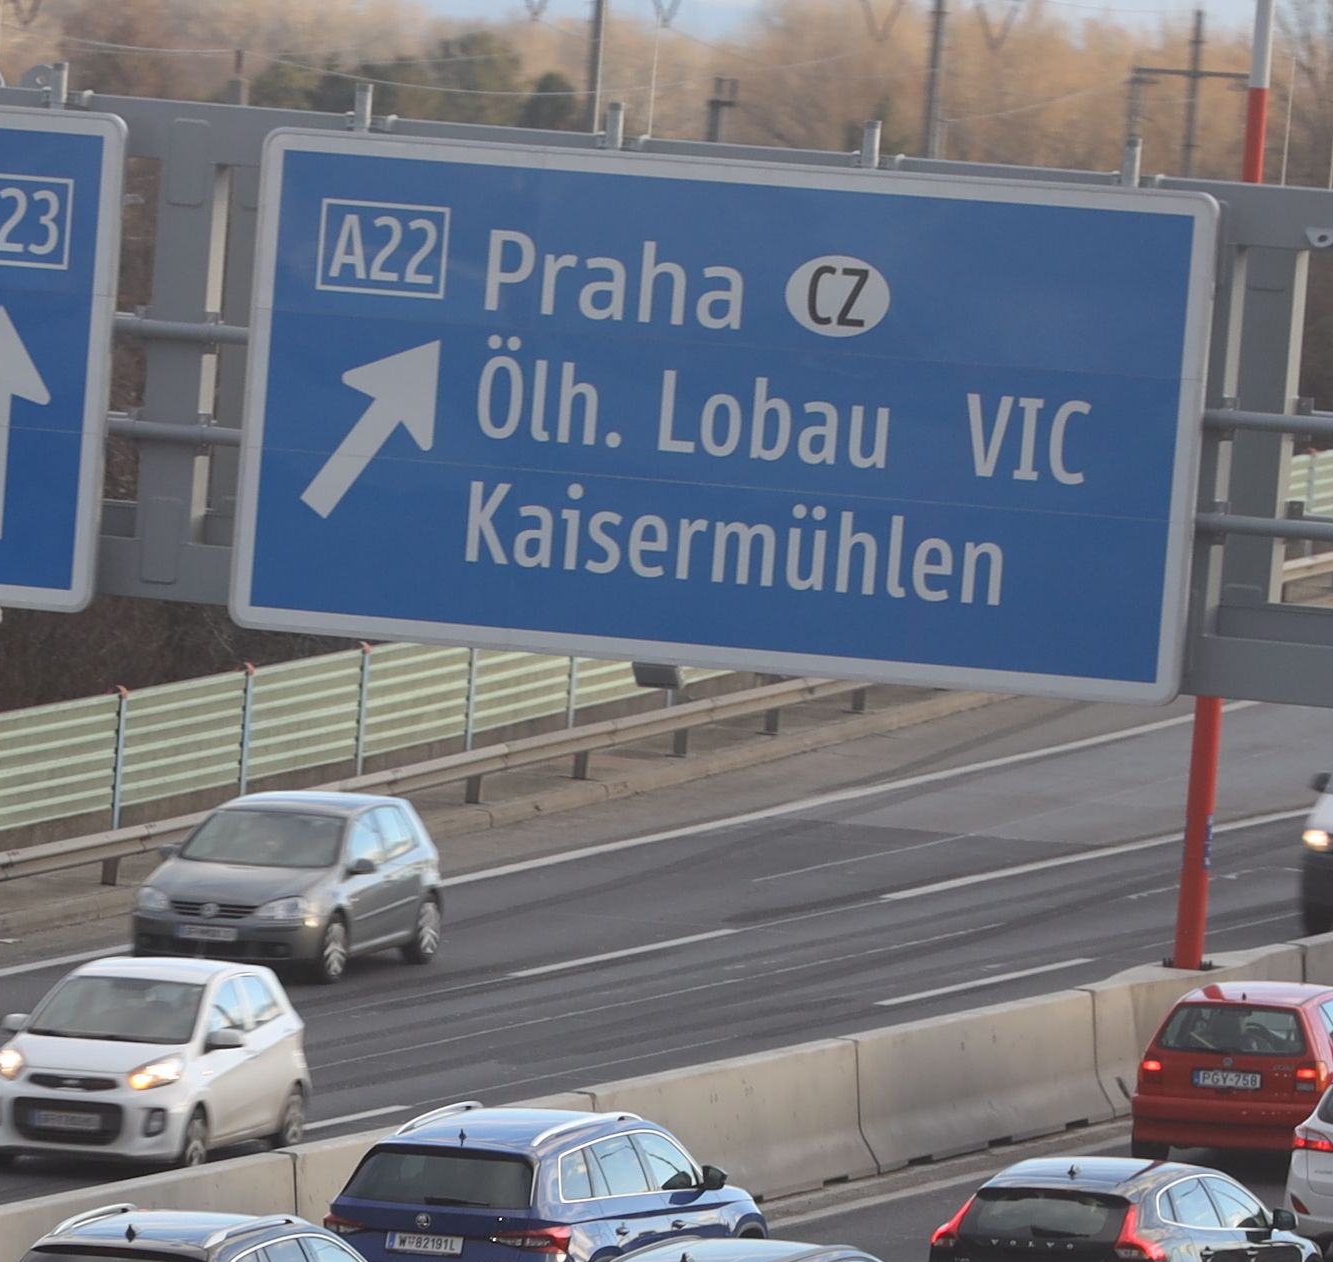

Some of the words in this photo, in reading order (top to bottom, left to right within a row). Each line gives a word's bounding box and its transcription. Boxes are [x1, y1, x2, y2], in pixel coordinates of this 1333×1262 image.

[328, 213, 438, 285] A22
[484, 229, 744, 330] Praha
[807, 265, 870, 328] CZ
[477, 334, 622, 448] Ölh.
[657, 369, 890, 469] Lobau
[966, 392, 1092, 485] VIC
[465, 480, 1004, 606] Kaisermühlen
[1201, 1072, 1258, 1087] PGY-758
[991, 1238, 1073, 1249] VOLVO
